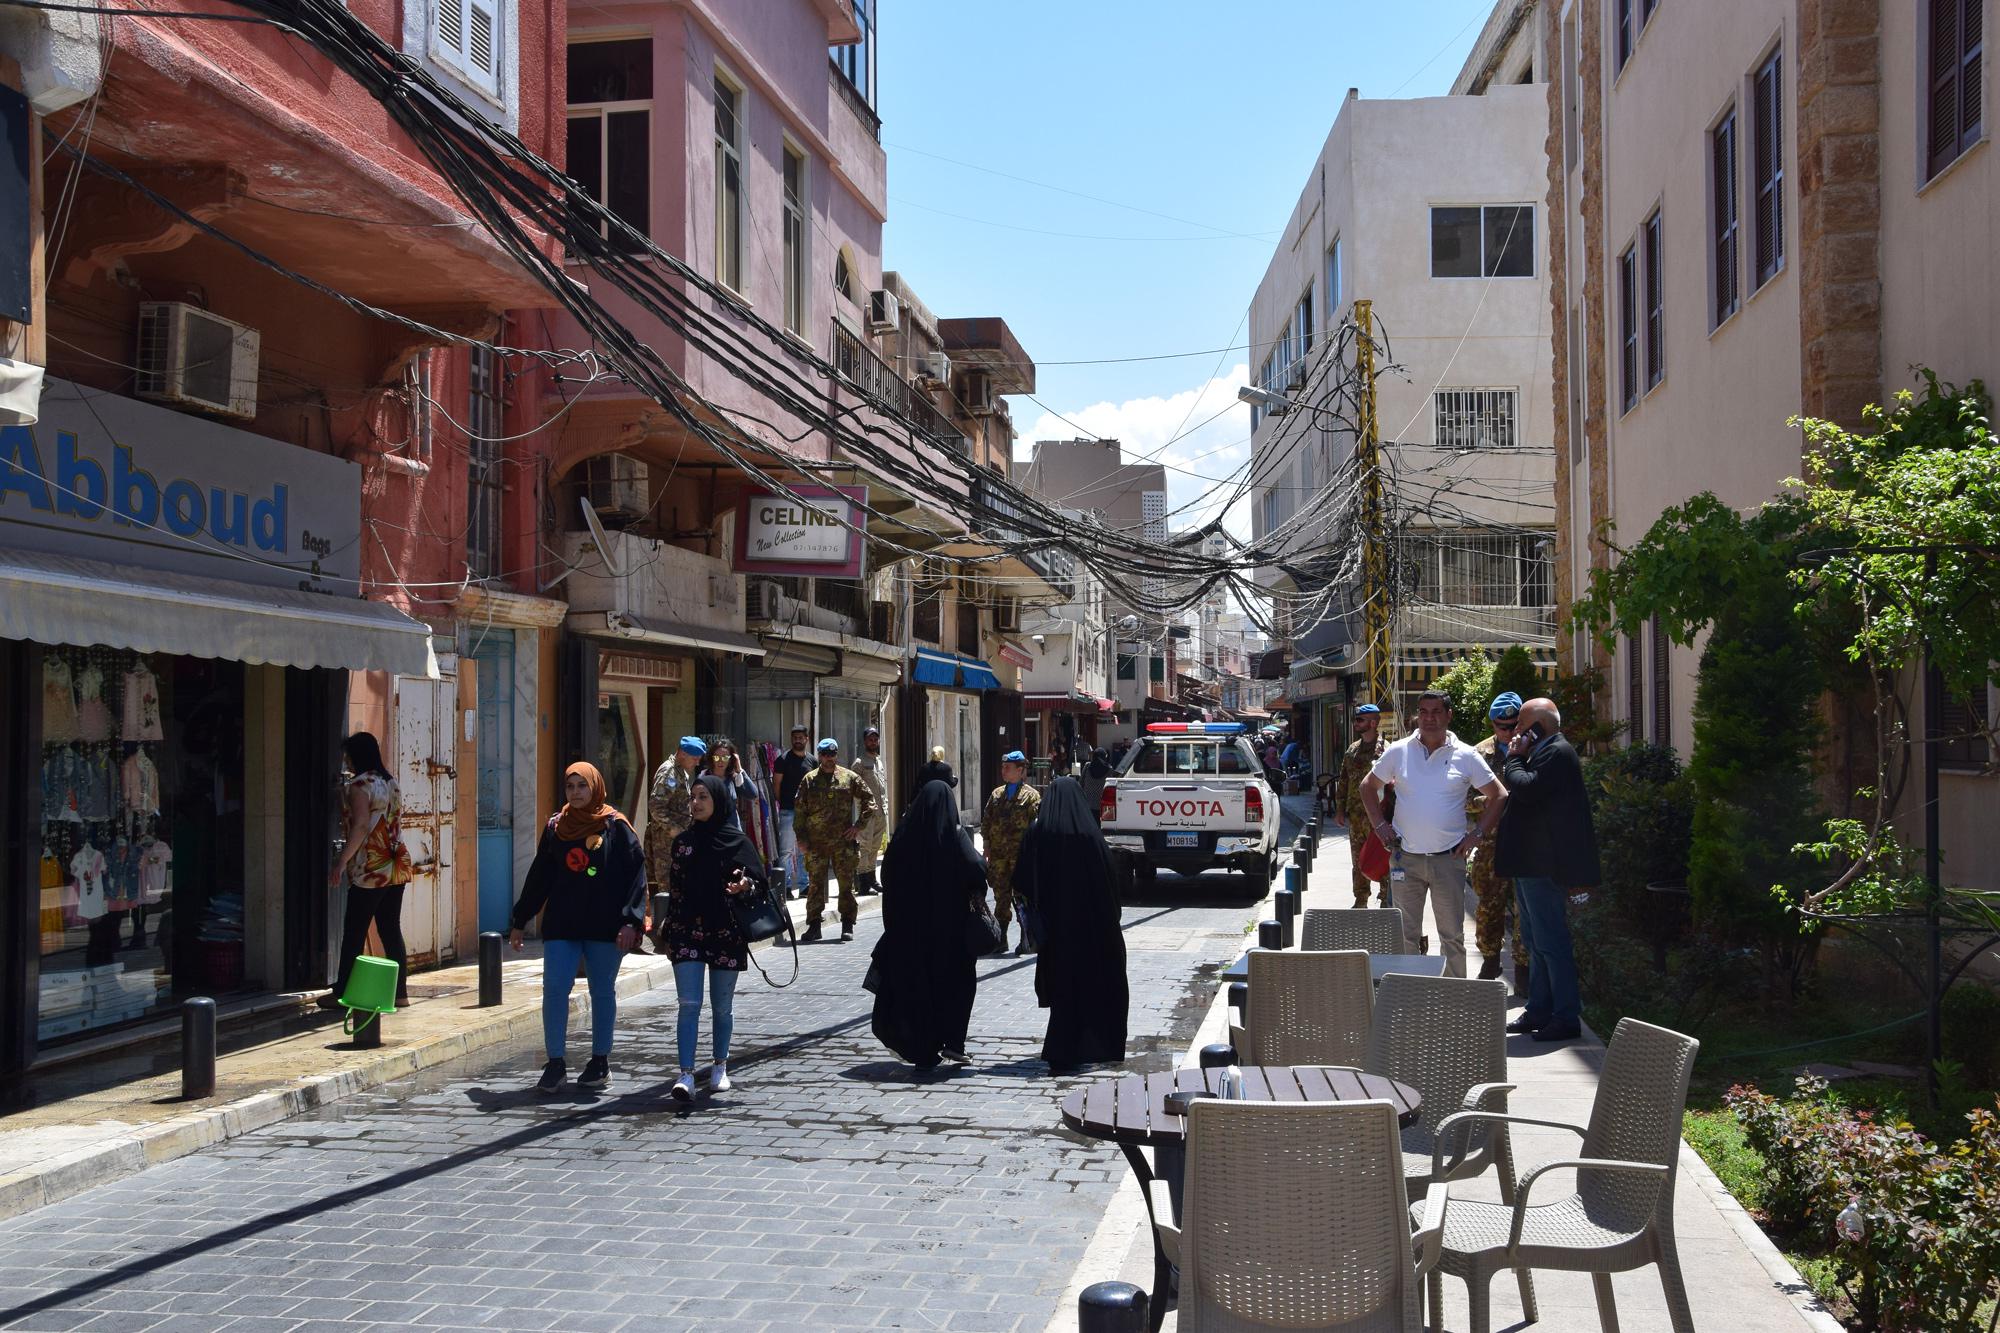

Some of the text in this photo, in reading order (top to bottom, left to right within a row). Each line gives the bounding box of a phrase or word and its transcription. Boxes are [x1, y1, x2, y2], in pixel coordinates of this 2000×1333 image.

[0, 425, 289, 556] Abboud
[760, 507, 838, 526] CELINE
[757, 529, 806, 552] New Collection
[1136, 800, 1225, 817] TOYOTA
